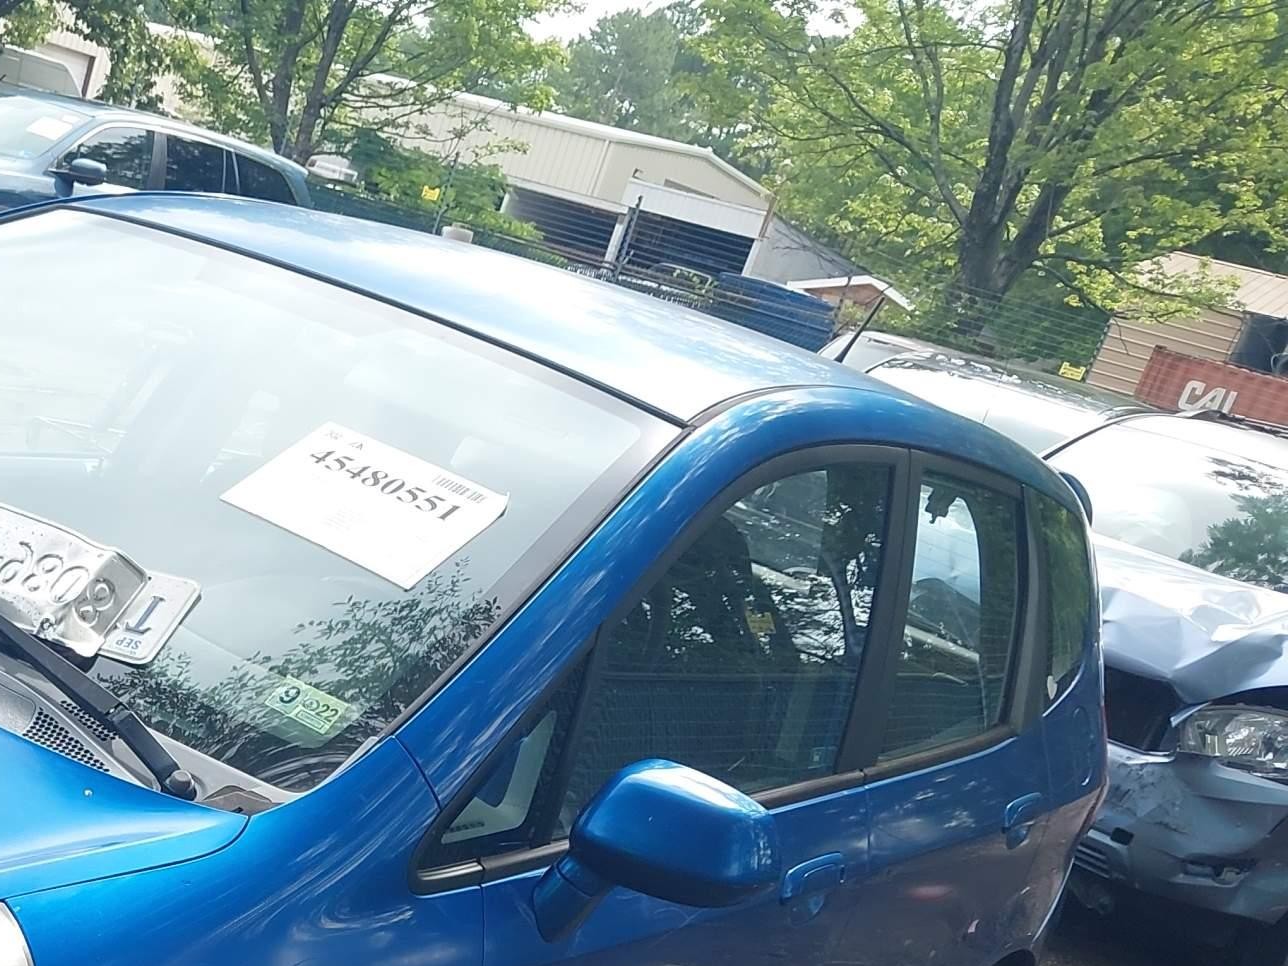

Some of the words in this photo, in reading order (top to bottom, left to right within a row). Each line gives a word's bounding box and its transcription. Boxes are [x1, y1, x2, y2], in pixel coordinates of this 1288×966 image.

[310, 450, 461, 521] 45480551
[115, 636, 142, 650] SEP
[279, 686, 301, 704] 9
[315, 703, 339, 723] 22
